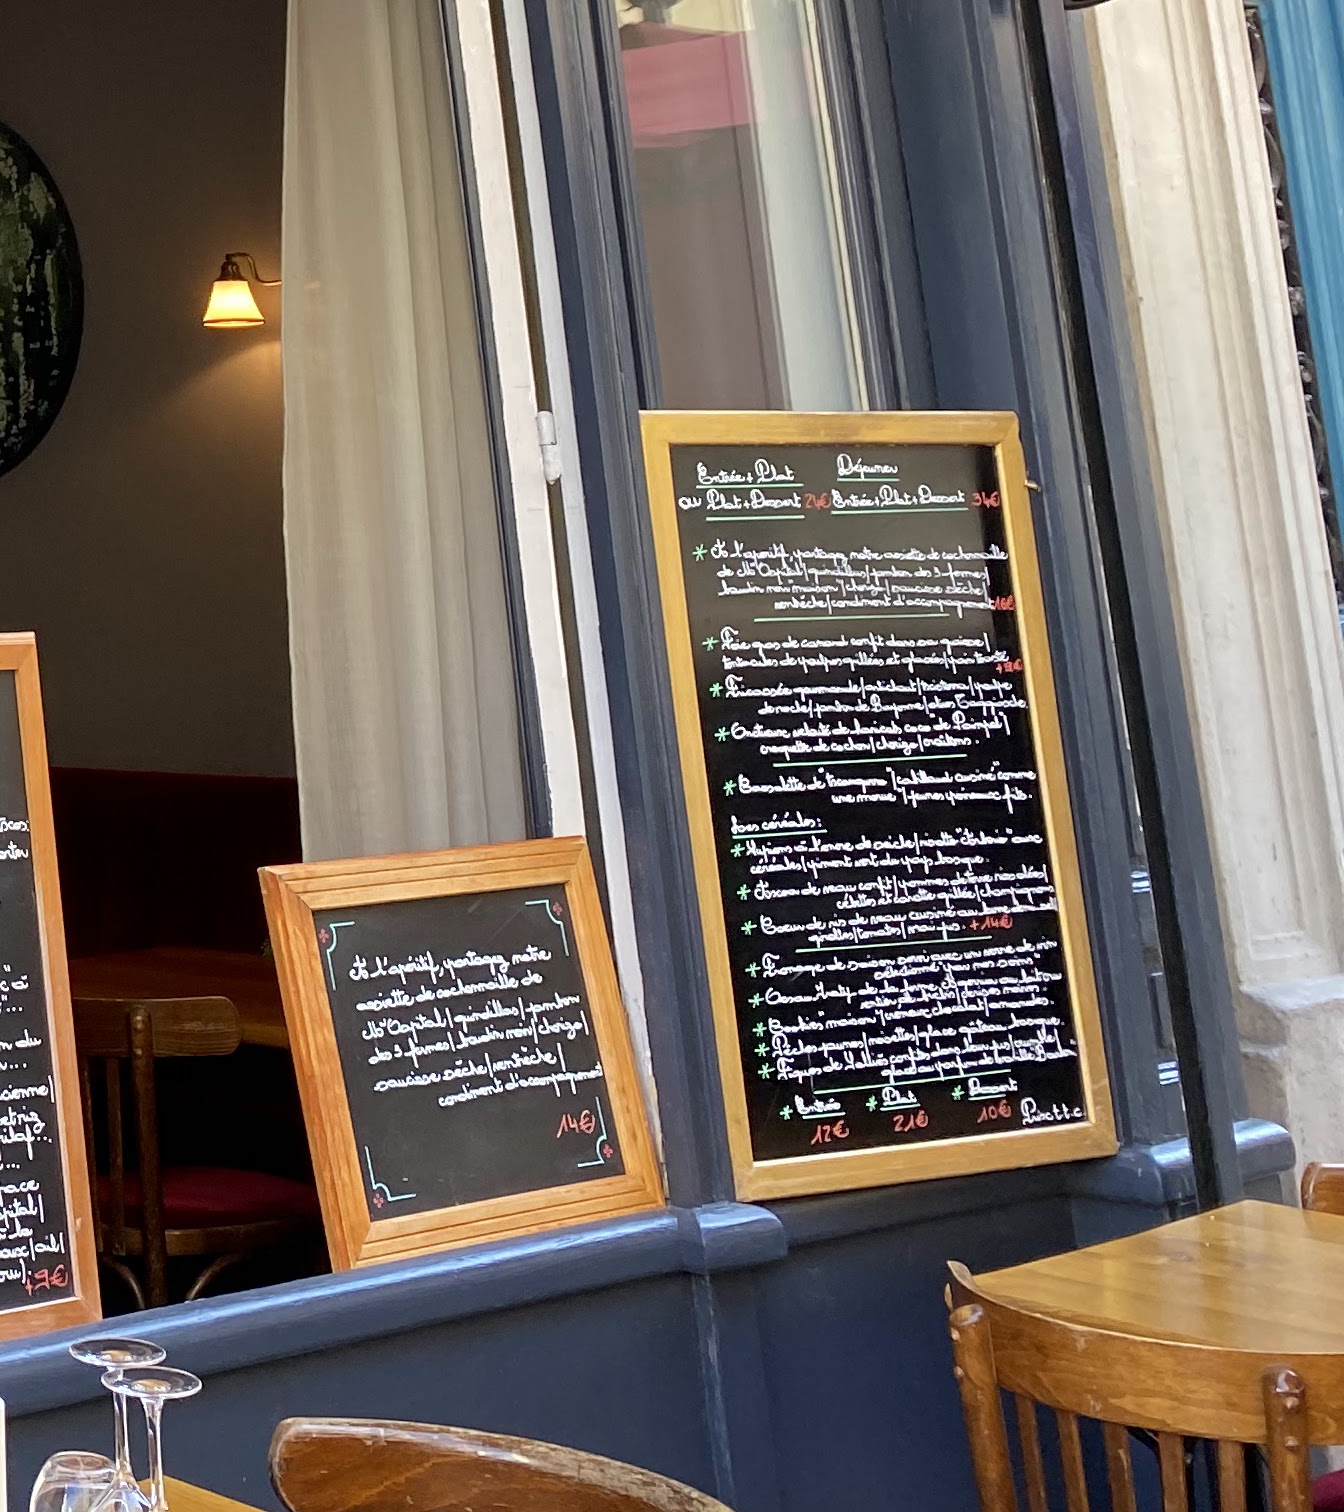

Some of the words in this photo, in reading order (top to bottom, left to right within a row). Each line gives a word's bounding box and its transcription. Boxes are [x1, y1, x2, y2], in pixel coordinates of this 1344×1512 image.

[415, 984, 436, 1002] de
[521, 969, 543, 985] de
[14, 1028, 42, 1049] du
[368, 1044, 393, 1065] des
[373, 1071, 441, 1092] saucisse
[893, 1109, 929, 1132] 21€
[976, 1099, 1012, 1124] 10€
[556, 1109, 597, 1139] 14€
[8, 1218, 34, 1240] la
